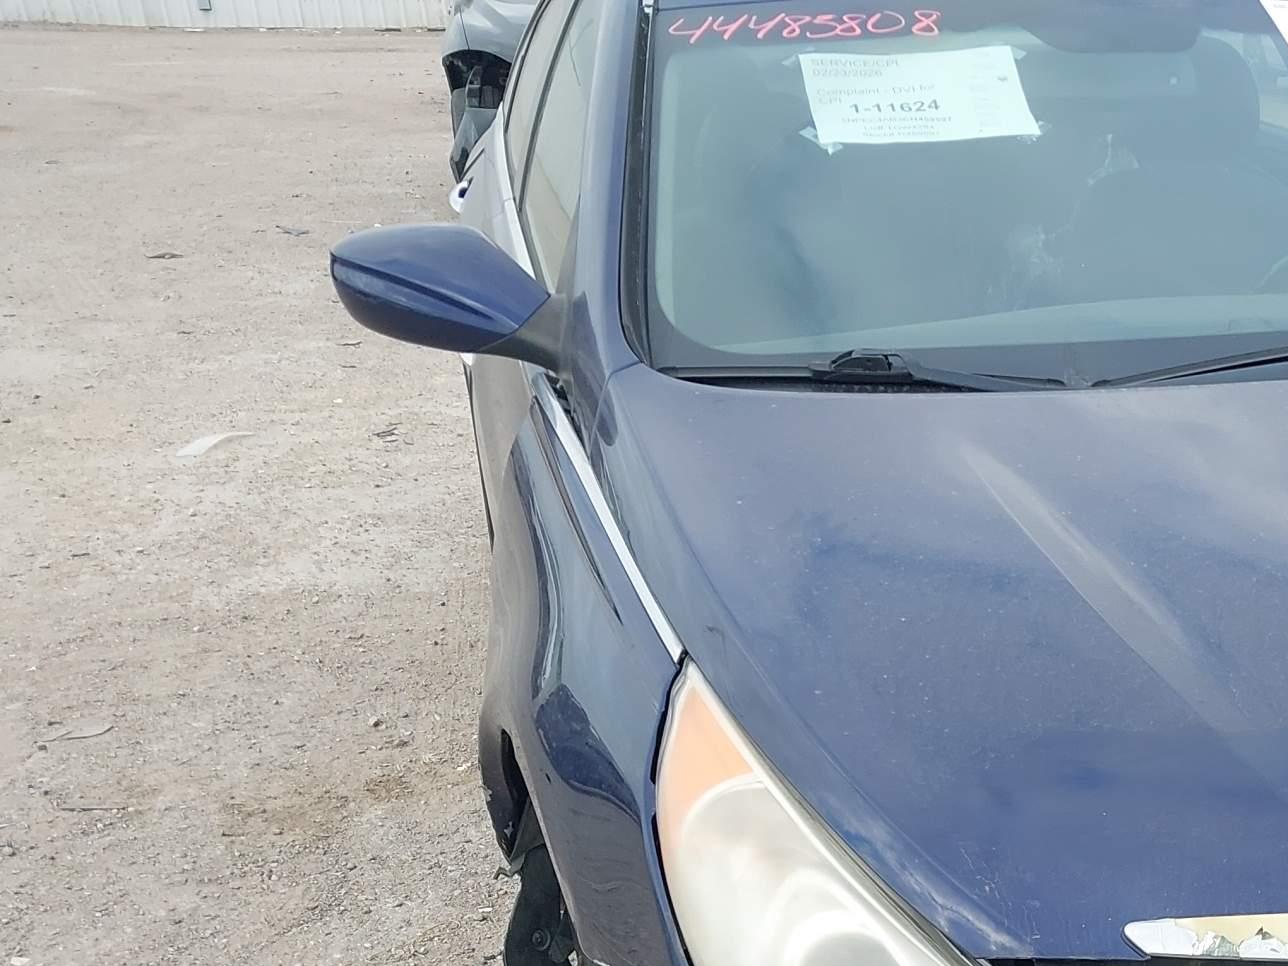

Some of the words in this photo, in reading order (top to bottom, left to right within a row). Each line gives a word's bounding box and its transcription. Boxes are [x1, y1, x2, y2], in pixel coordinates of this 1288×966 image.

[668, 10, 942, 45] 44485808
[817, 87, 880, 97] Complaint
[849, 98, 941, 114] 1-11624
